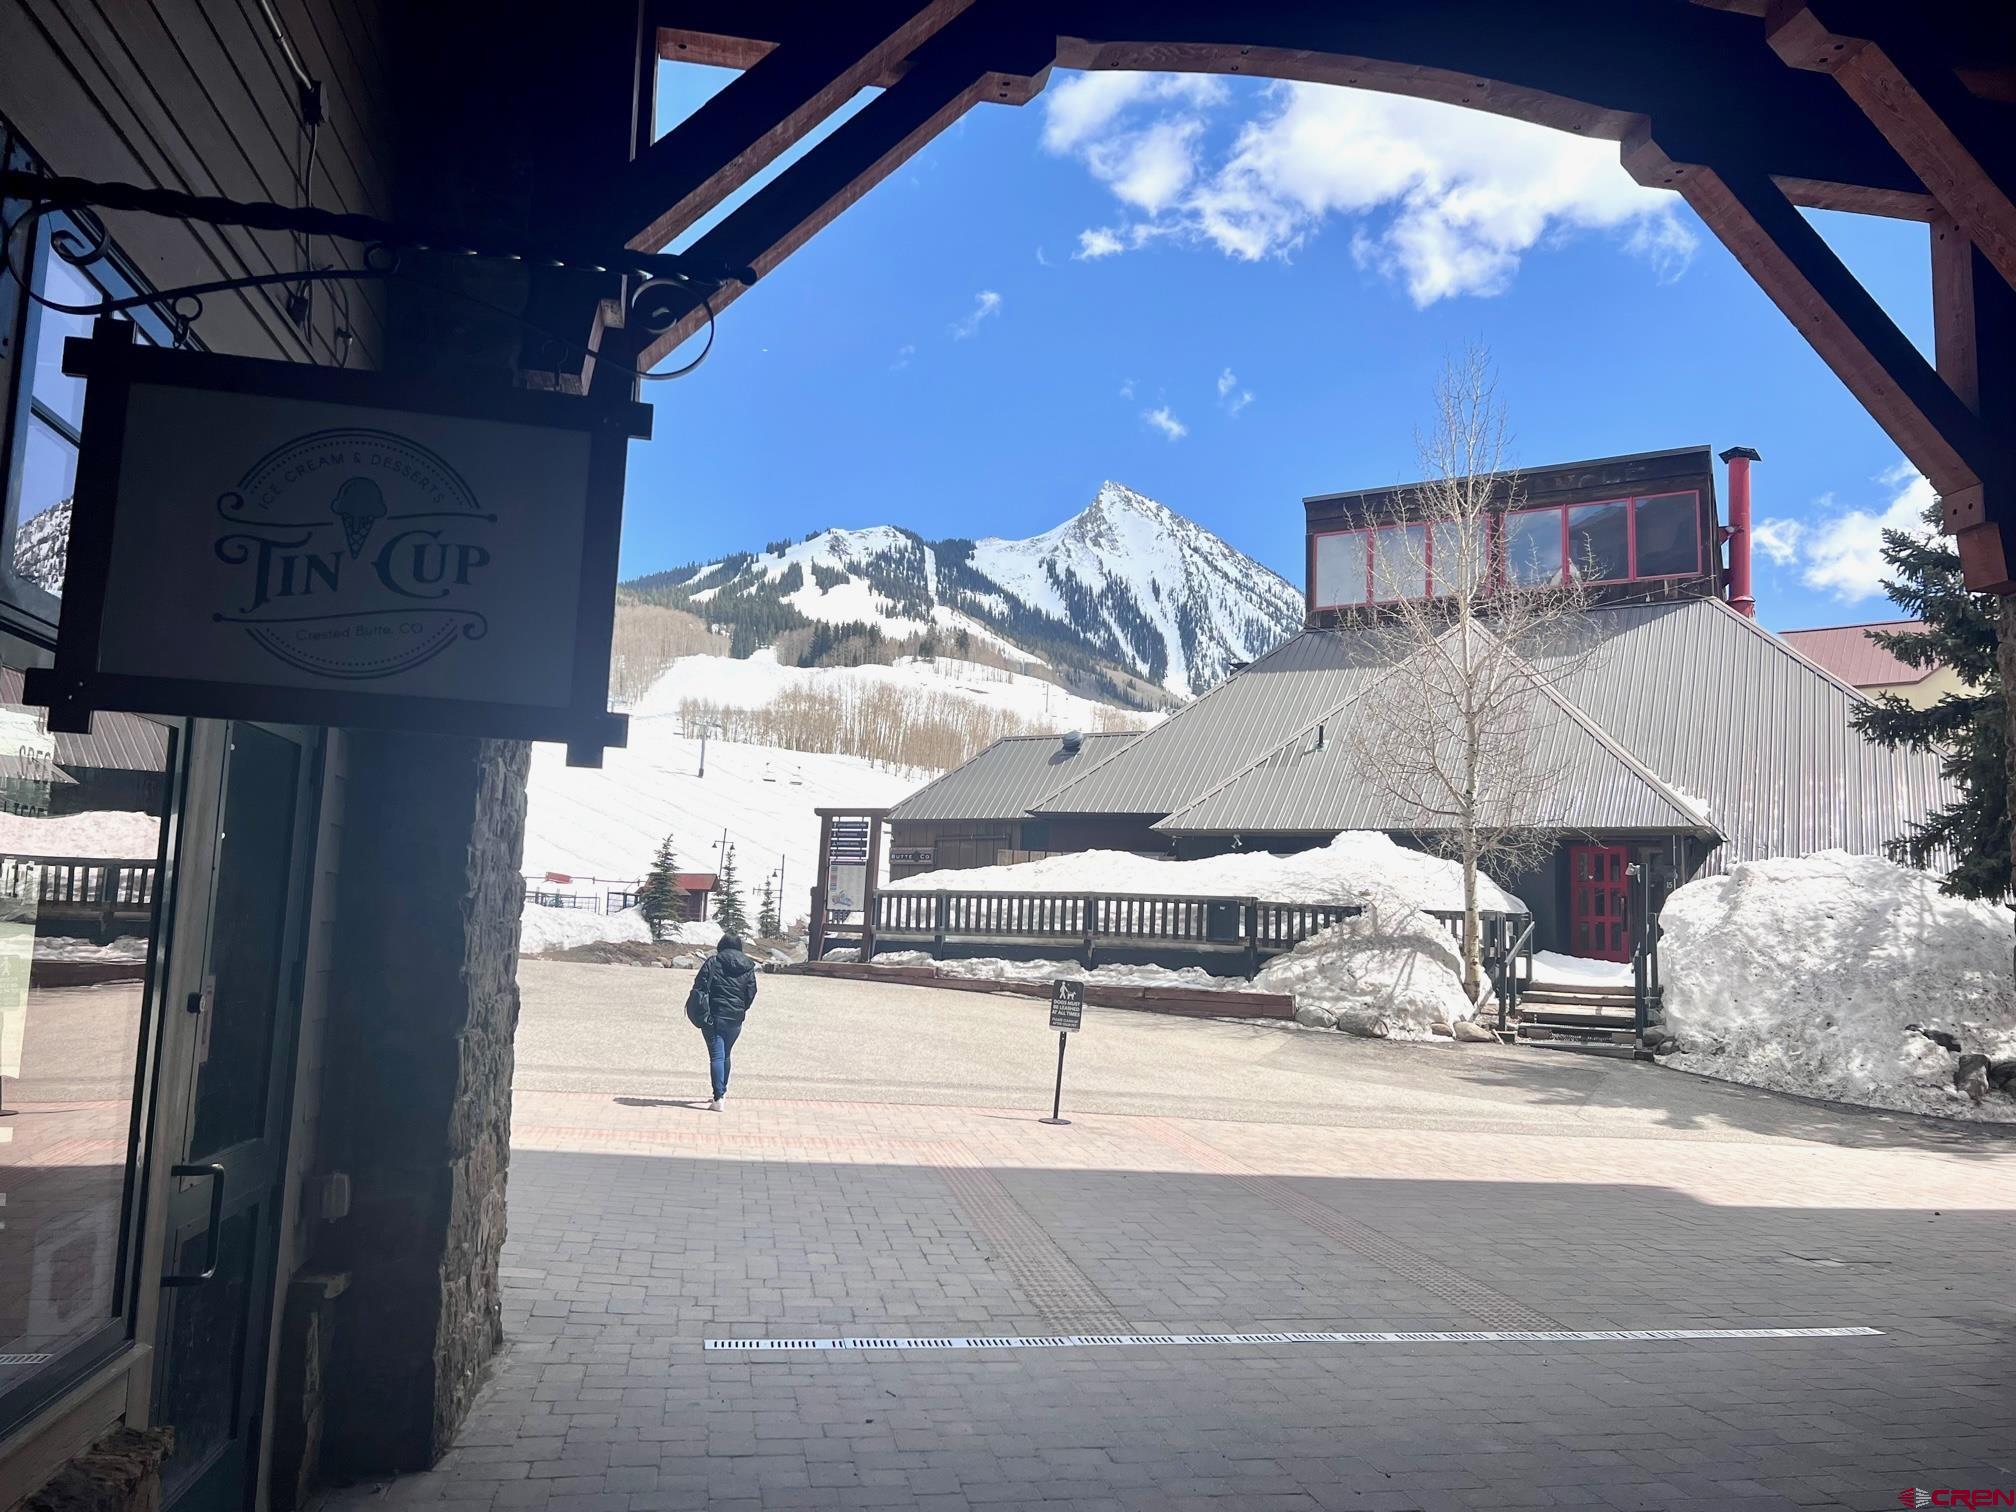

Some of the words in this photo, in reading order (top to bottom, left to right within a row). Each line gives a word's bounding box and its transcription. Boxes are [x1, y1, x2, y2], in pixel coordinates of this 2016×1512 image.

[258, 483, 282, 511] ICE
[284, 452, 346, 483] CREAM
[353, 452, 361, 464] &
[370, 453, 444, 504] DESSERTS
[214, 530, 346, 614] TIN
[370, 529, 491, 600] CUP
[295, 627, 350, 642] Crested
[399, 622, 424, 635] CO
